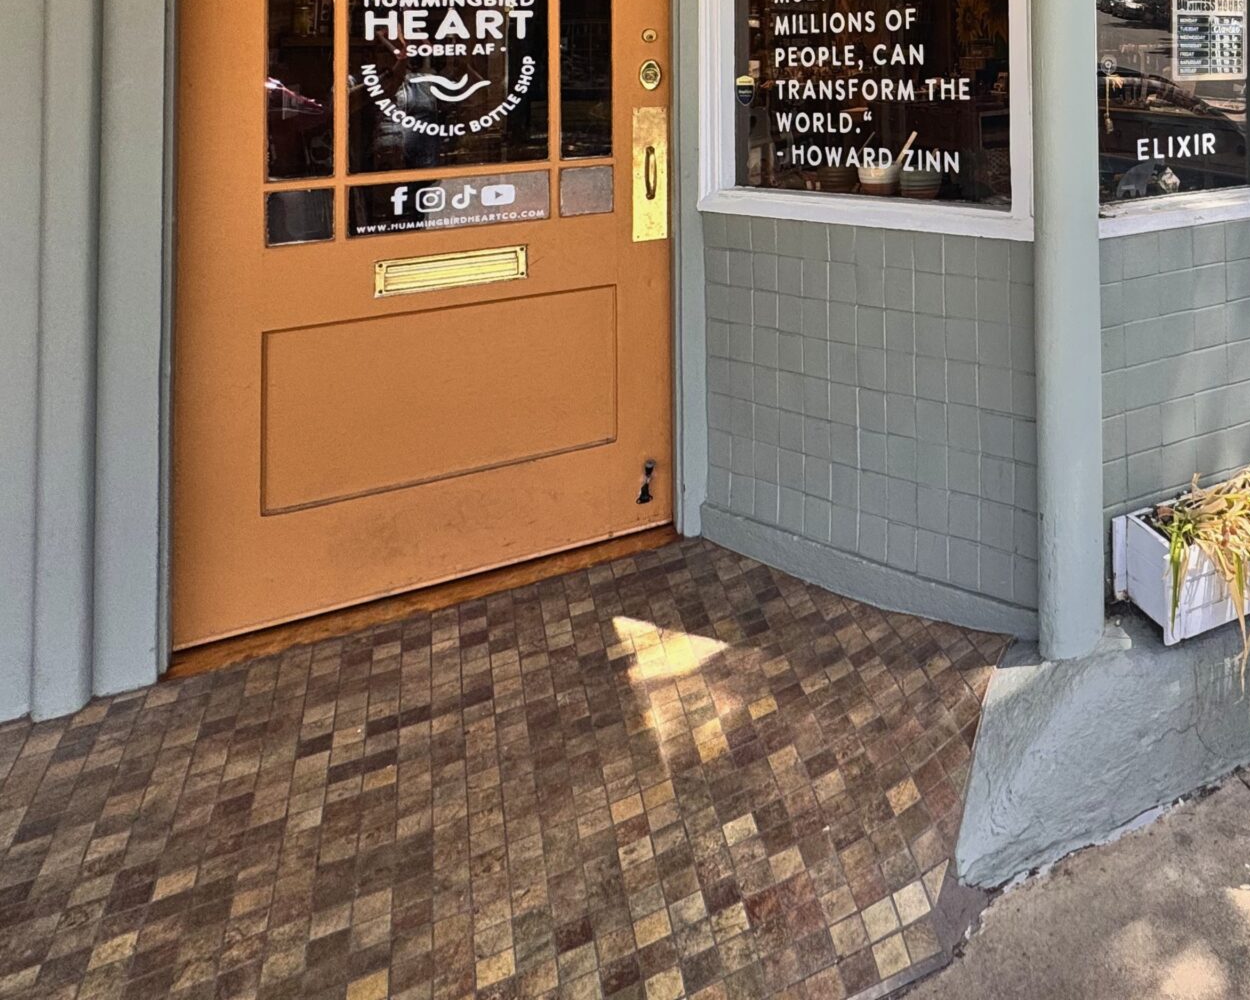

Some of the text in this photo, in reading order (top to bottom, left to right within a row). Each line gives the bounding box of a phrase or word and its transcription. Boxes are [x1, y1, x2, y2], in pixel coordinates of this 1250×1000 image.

[1218, 0, 1243, 11] HOURS
[364, 10, 534, 41] HEART
[774, 8, 917, 36] MILLIONS OF
[406, 43, 496, 57] SOBER AF
[775, 44, 924, 70] PEOPLE, CAN
[361, 55, 536, 137] NON ALCOHOLIC BOTTLE SHOP
[776, 78, 971, 101] TRANSFORM THE
[791, 145, 893, 169] HOWARD
[902, 149, 960, 174] ZINN
[1137, 132, 1217, 161] ELIXIR
[356, 209, 545, 234] WWW.HUMMINGBIRDHEARTCO.COM
